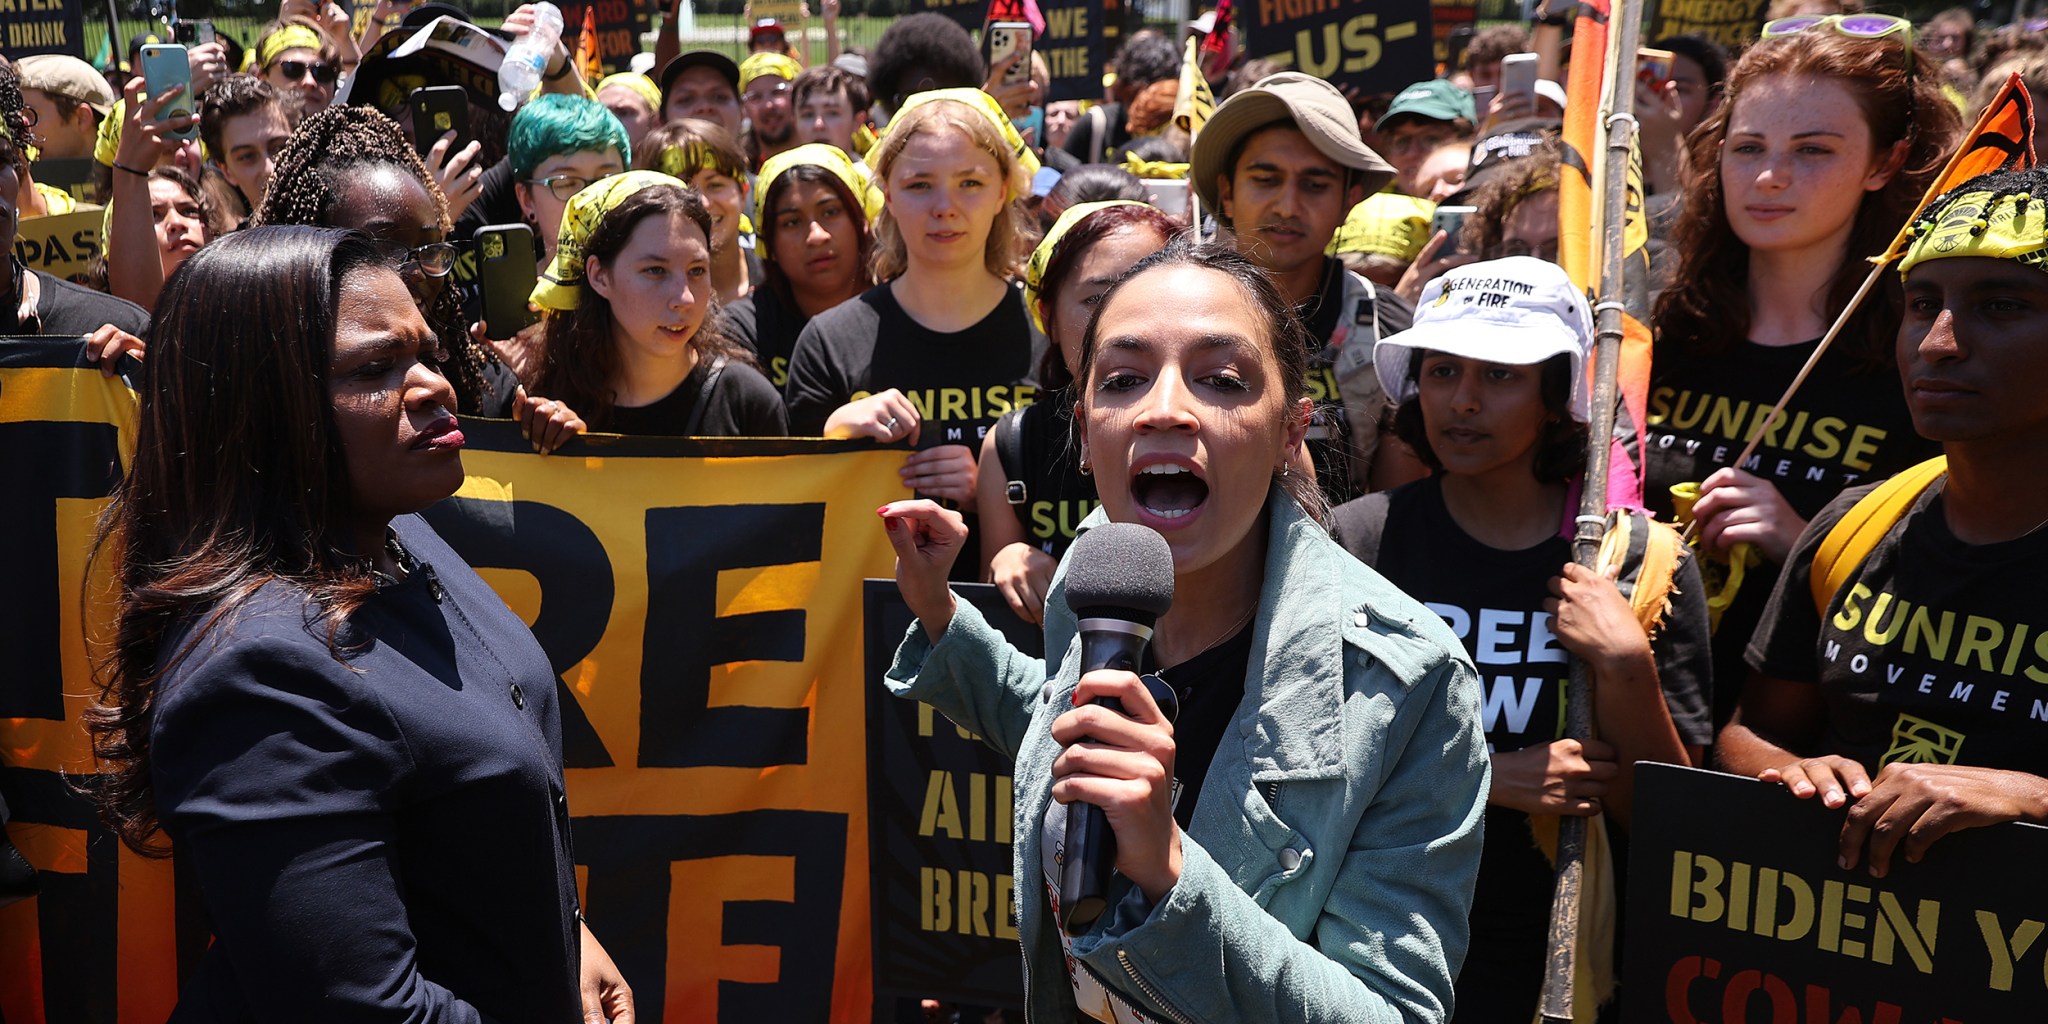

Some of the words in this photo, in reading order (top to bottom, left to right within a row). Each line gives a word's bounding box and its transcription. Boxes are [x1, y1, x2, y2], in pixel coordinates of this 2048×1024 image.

[9, 20, 66, 48] DRINK
[1047, 7, 1089, 39] WE
[1450, 277, 1533, 296] GENERATION
[1478, 292, 1510, 308] FIRE
[1646, 386, 1888, 471] SUNRISE
[1645, 433, 1859, 484] OVEMENT
[1670, 850, 1940, 974] BIDEN
